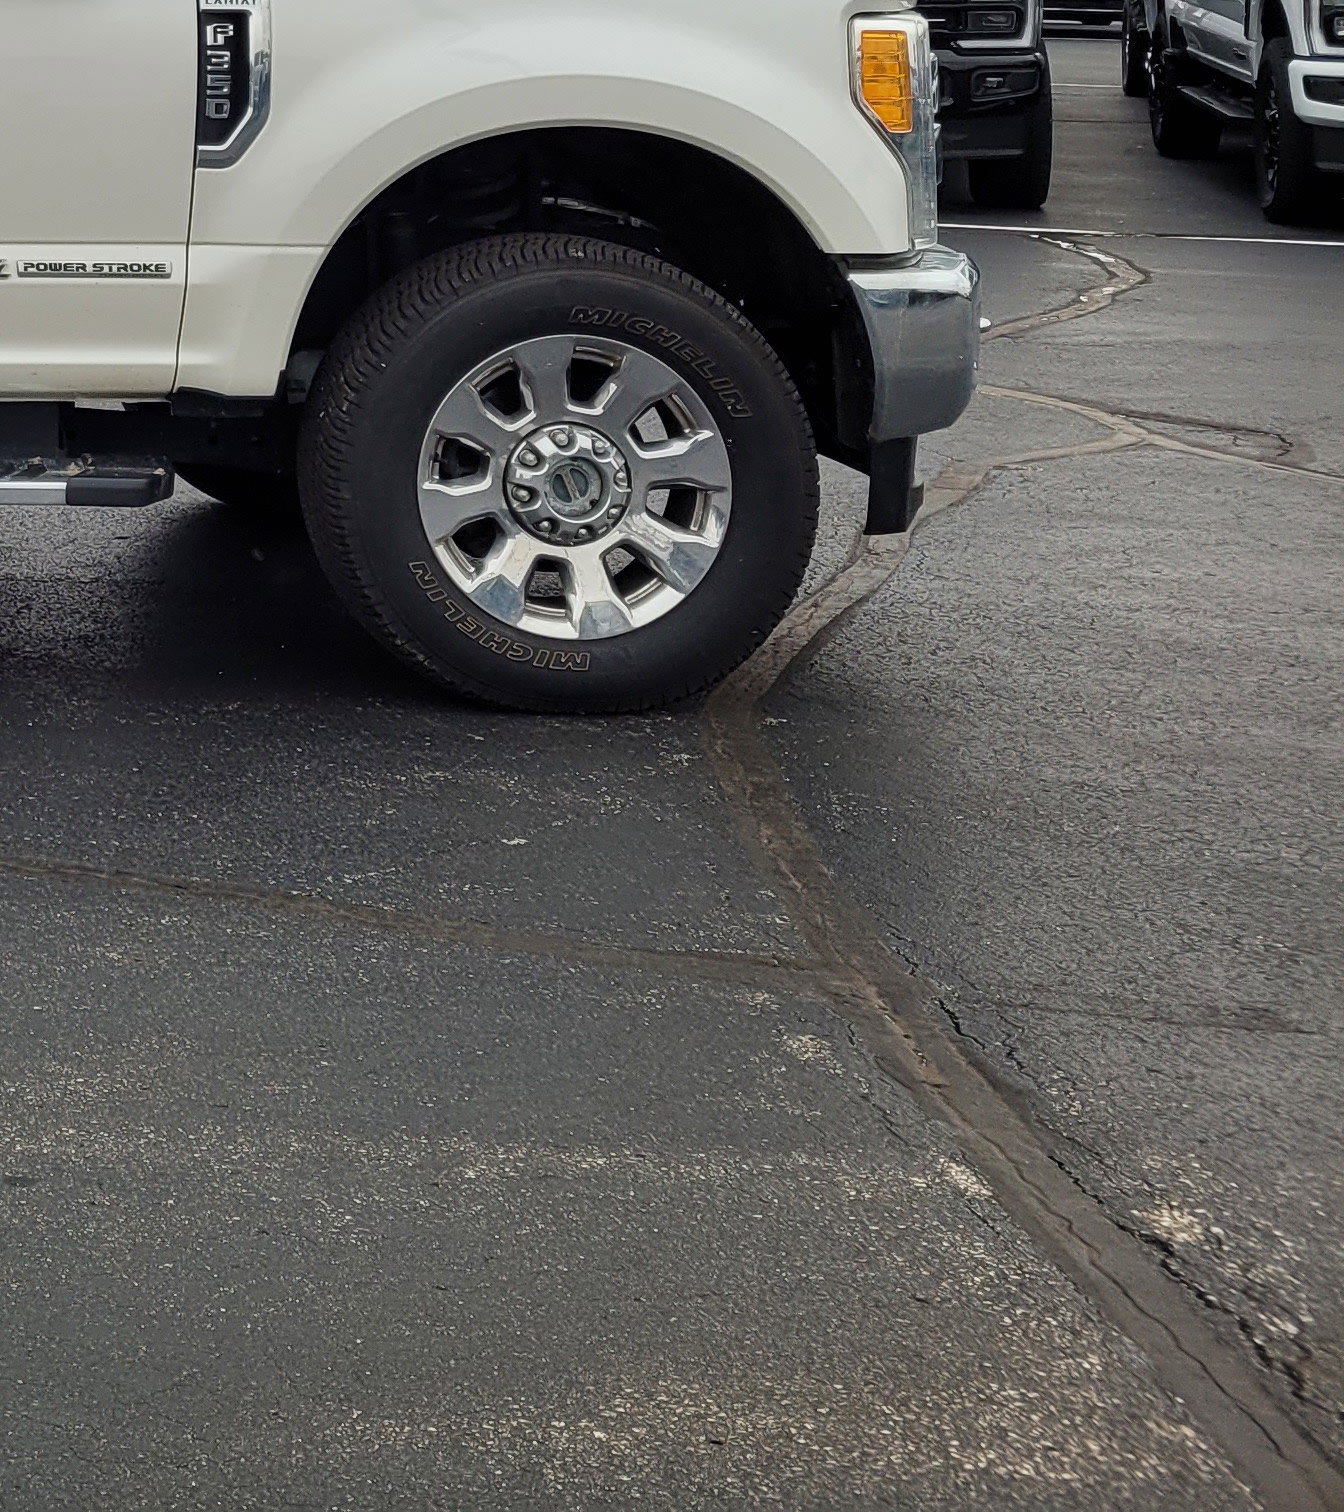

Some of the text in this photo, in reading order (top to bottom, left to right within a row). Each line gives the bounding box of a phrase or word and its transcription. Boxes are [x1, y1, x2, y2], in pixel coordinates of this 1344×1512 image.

[22, 262, 87, 273] POWER
[91, 262, 168, 273] STROKE
[568, 305, 753, 419] MICHELIN
[408, 560, 590, 672] MICHELIN
